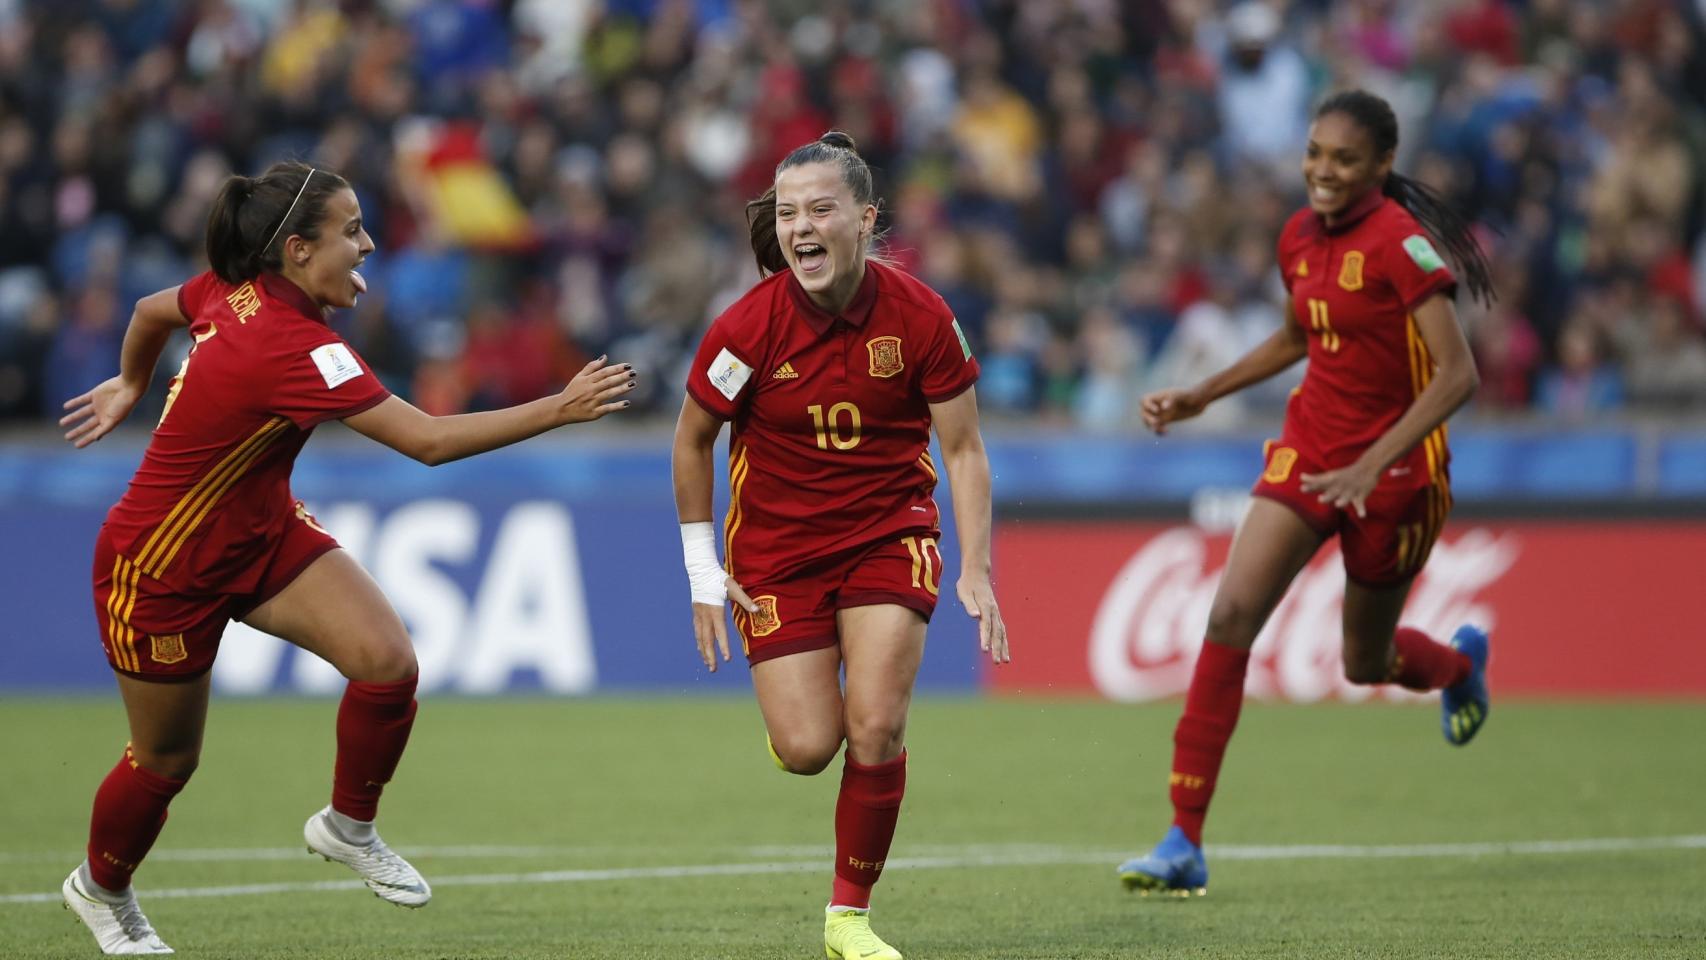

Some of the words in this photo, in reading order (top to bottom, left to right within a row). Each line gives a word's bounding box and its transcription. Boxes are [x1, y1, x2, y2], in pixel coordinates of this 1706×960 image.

[226, 281, 262, 324] IRENE
[1307, 297, 1340, 353] 11
[772, 370, 799, 379] adidas
[807, 401, 862, 450] 10
[900, 536, 942, 596] 10
